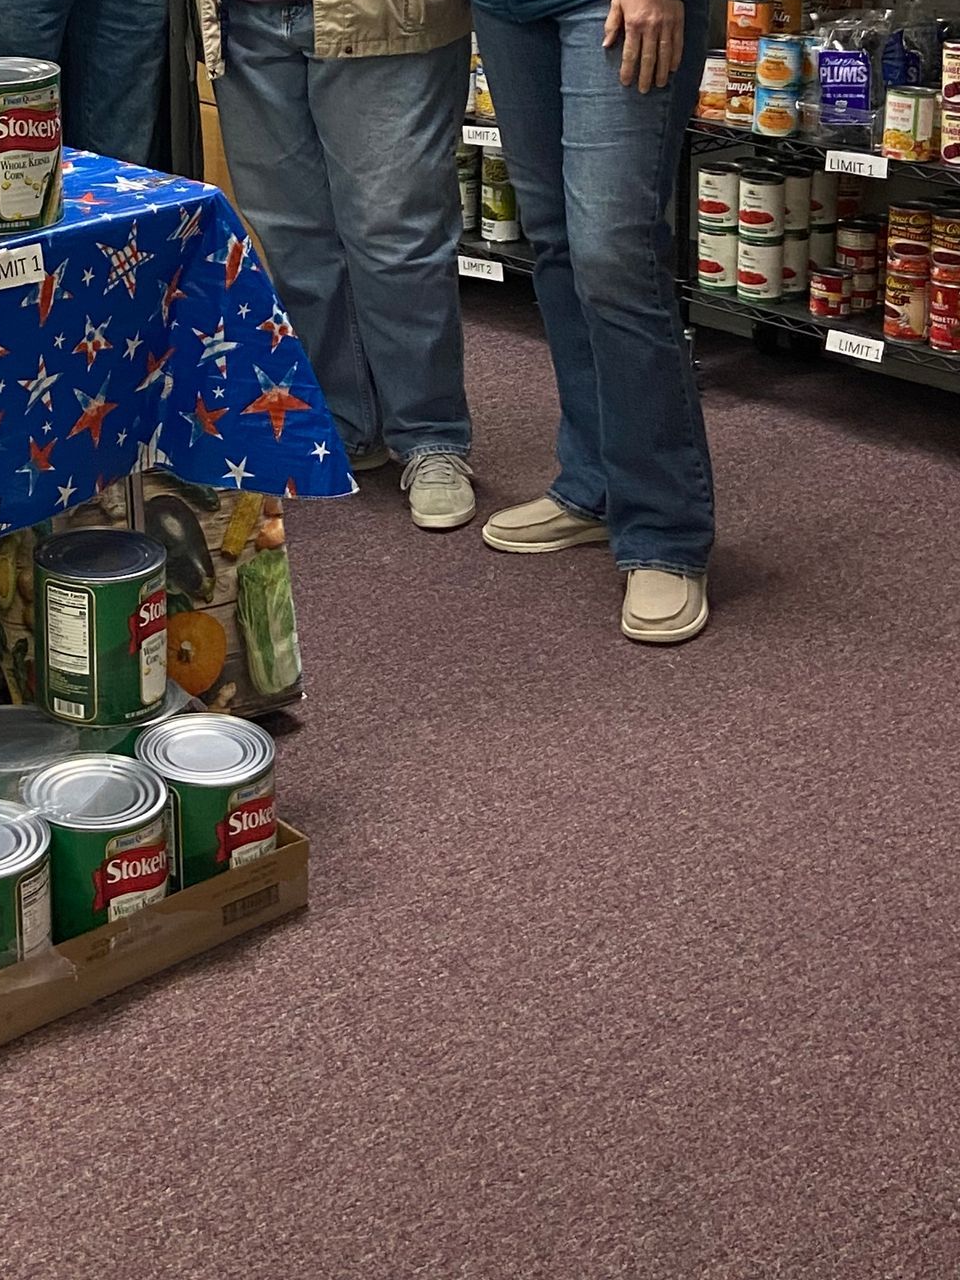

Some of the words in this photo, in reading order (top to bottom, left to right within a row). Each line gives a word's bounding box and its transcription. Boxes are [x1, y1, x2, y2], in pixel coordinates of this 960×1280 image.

[820, 66, 868, 83] PLUMS
[467, 129, 490, 141] LIMIT
[492, 132, 498, 141] 2
[0, 160, 27, 171] WHOLE
[829, 158, 864, 174] LIMIT
[868, 164, 874, 176] 1
[4, 170, 25, 181] CORN
[31, 255, 42, 272] 1
[463, 260, 485, 274] LIMIT
[486, 263, 492, 274] 2
[838, 339, 871, 358] LIMIT
[875, 348, 880, 360] 1
